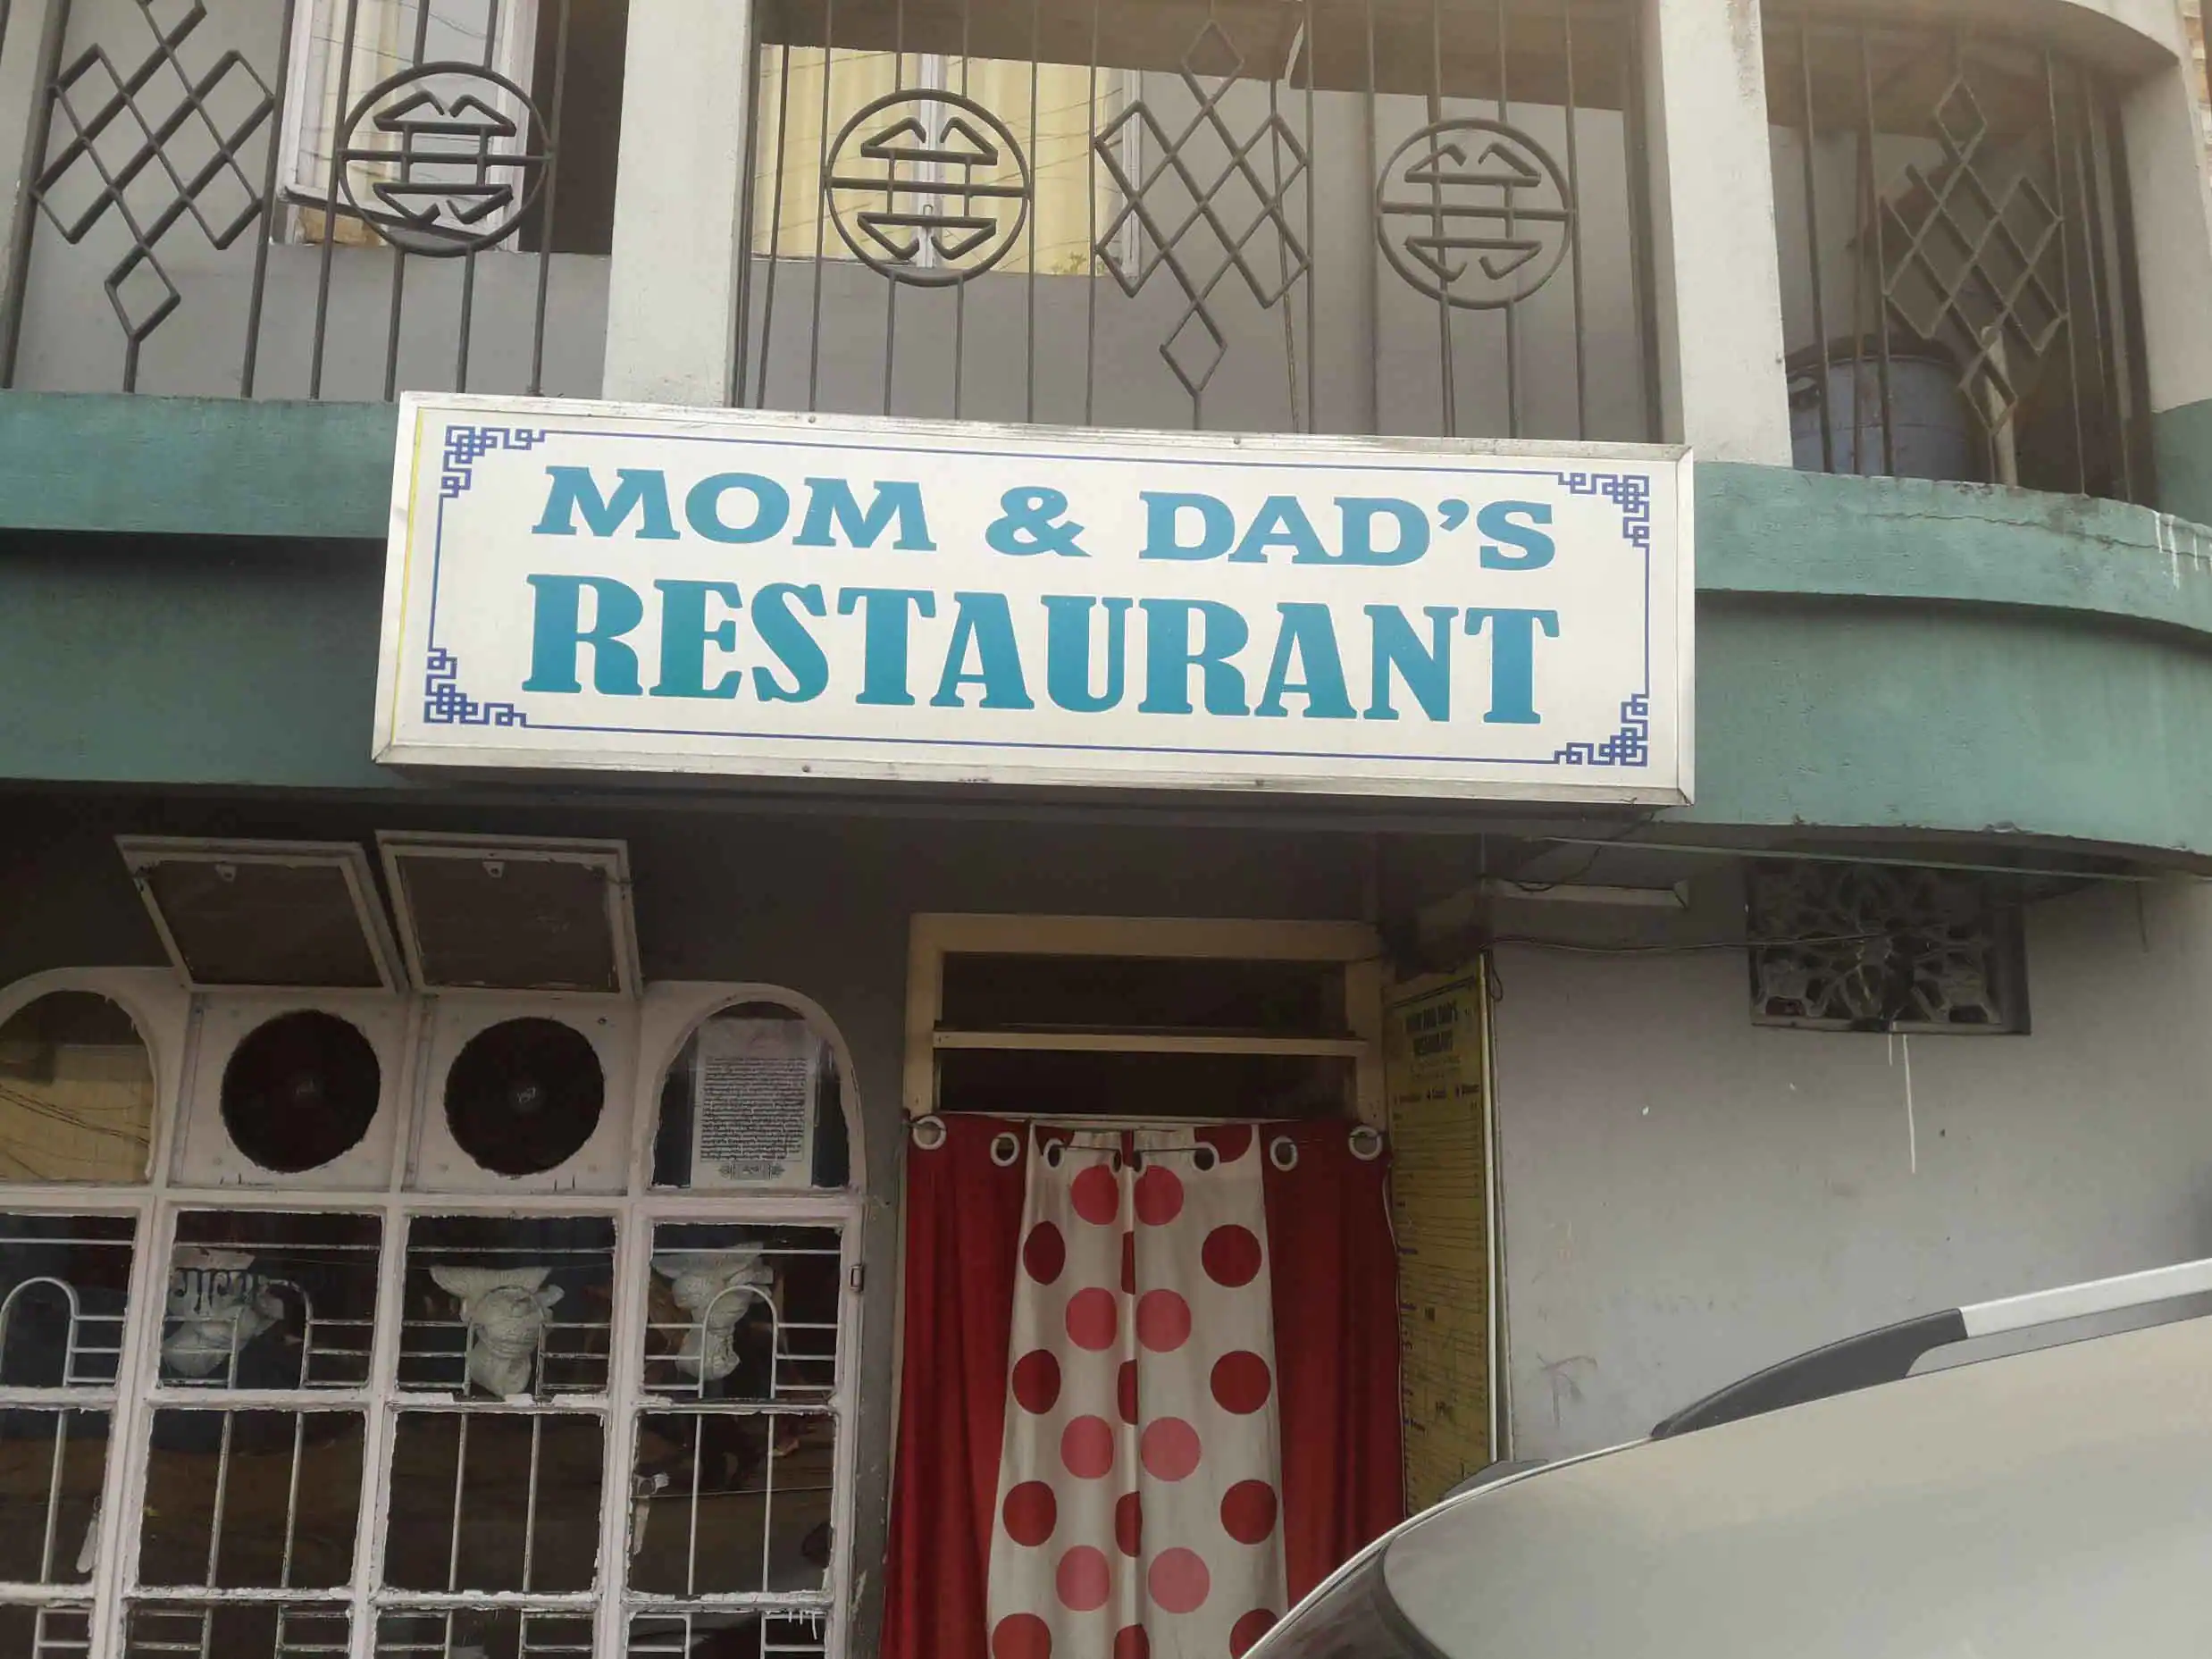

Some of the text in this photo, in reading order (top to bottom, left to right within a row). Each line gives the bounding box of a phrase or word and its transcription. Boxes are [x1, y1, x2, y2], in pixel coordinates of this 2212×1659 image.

[532, 466, 1556, 570] MOM & DAD’S
[521, 574, 1560, 725] RESTAURANT
